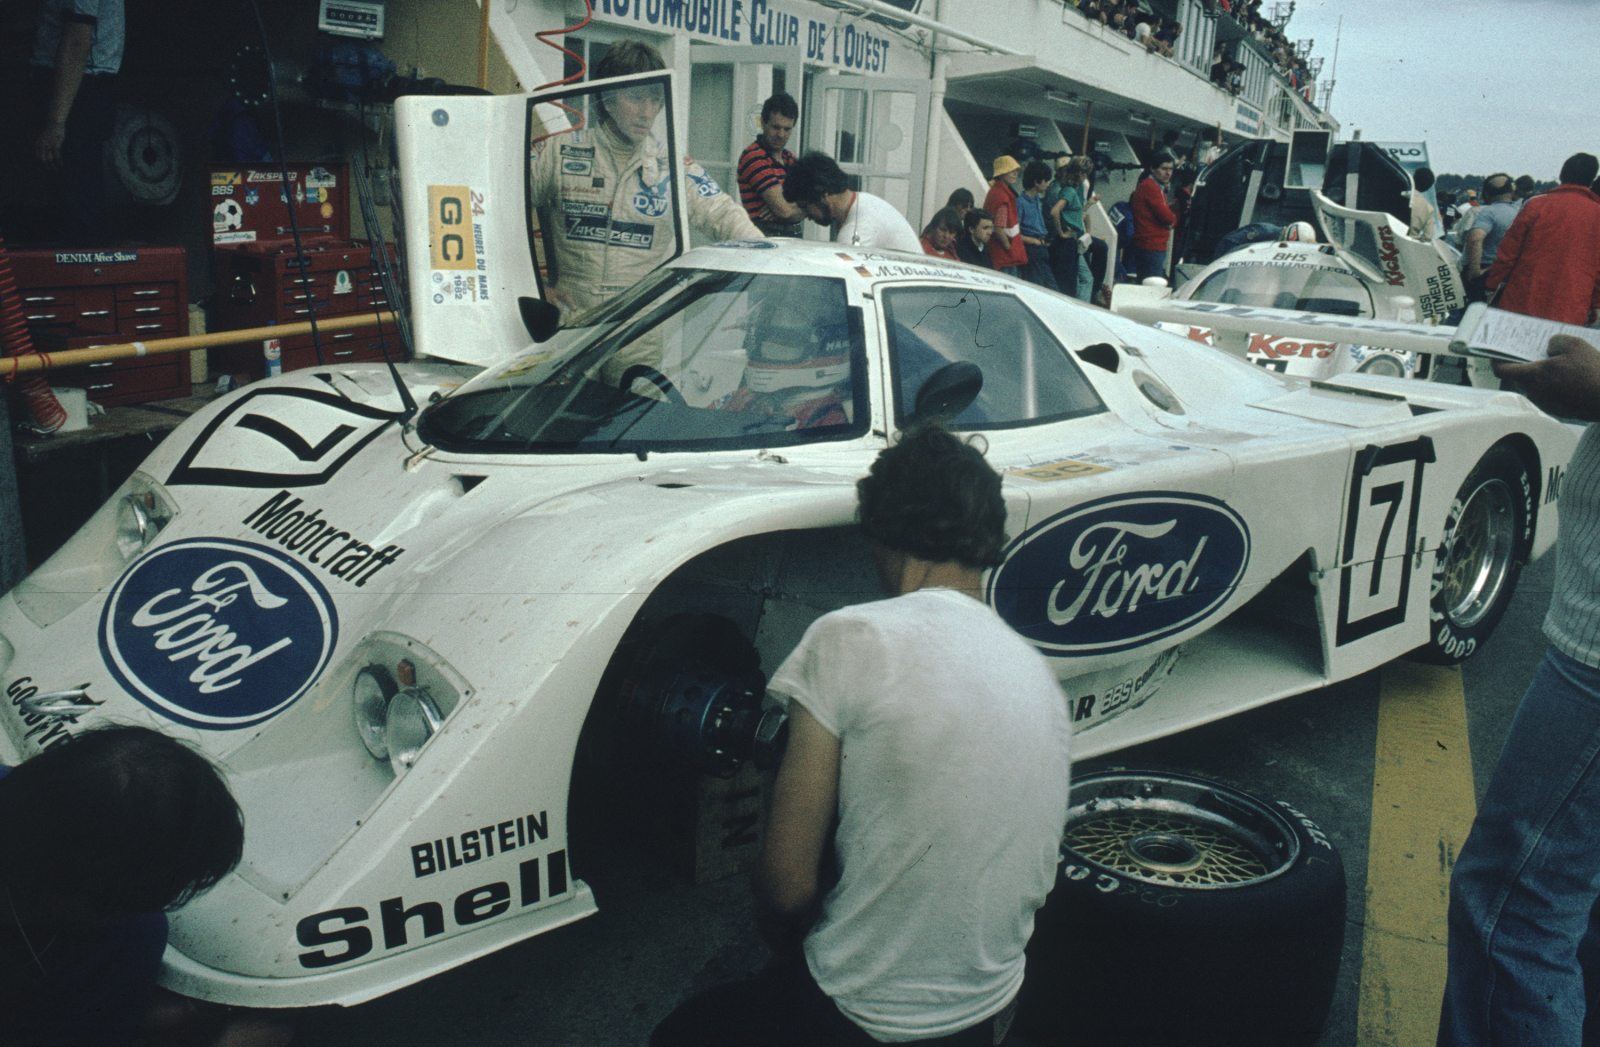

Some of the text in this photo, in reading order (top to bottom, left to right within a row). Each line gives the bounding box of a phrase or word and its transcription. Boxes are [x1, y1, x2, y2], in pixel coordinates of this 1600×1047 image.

[807, 20, 826, 60] DE
[212, 185, 235, 196] BBS
[634, 196, 668, 216] D&W
[55, 251, 136, 263] DENIM After Shave
[470, 190, 489, 301] 24 HEURES DU MANS
[1272, 253, 1309, 262] BHS
[454, 275, 463, 300] 1982
[1438, 264, 1458, 301] DRYVER
[242, 490, 406, 588] Motorcraft
[1368, 480, 1405, 597] 7
[1047, 518, 1210, 626] Ford
[131, 561, 293, 694] Ford
[1099, 677, 1133, 715] BBS
[410, 810, 549, 878] BILSTEIN
[296, 848, 568, 969] Shell
